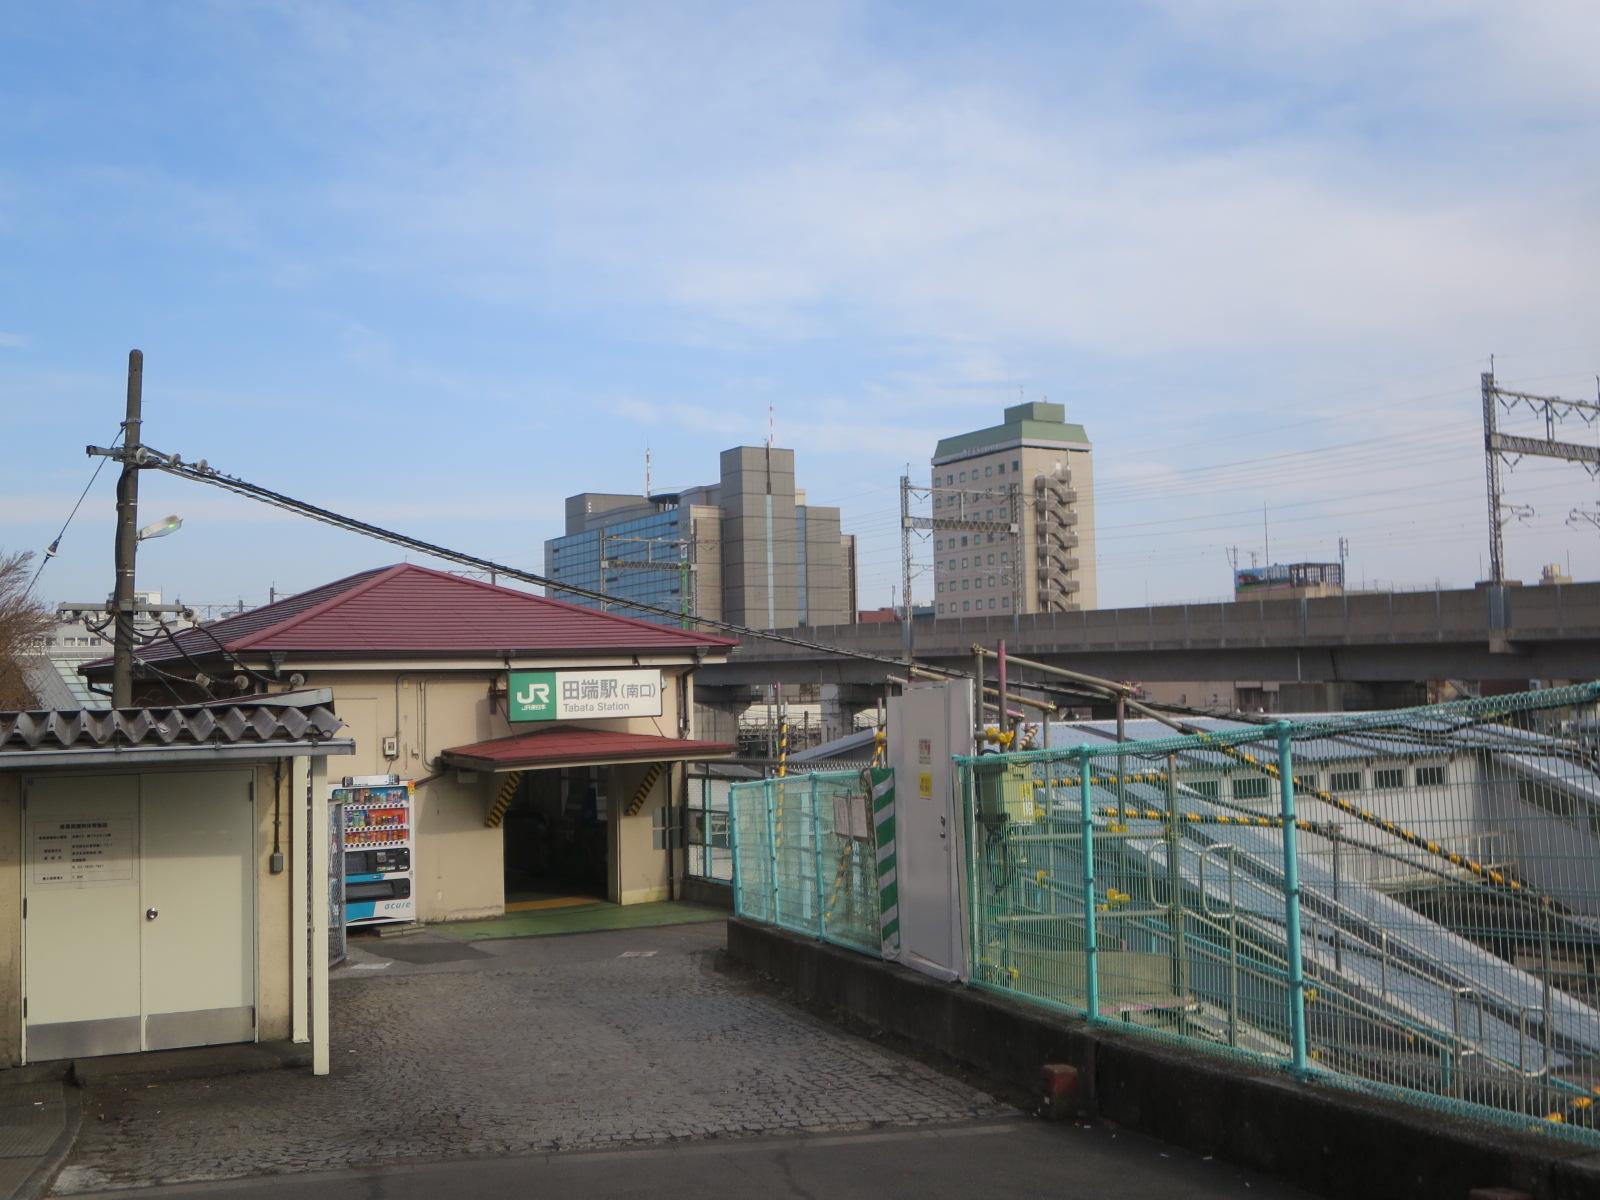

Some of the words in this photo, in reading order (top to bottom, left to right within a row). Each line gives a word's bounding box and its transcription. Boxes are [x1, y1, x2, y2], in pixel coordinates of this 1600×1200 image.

[516, 683, 550, 704] JR
[563, 703, 594, 712] Tabata
[597, 702, 630, 711] Station
[384, 901, 411, 910] acure
